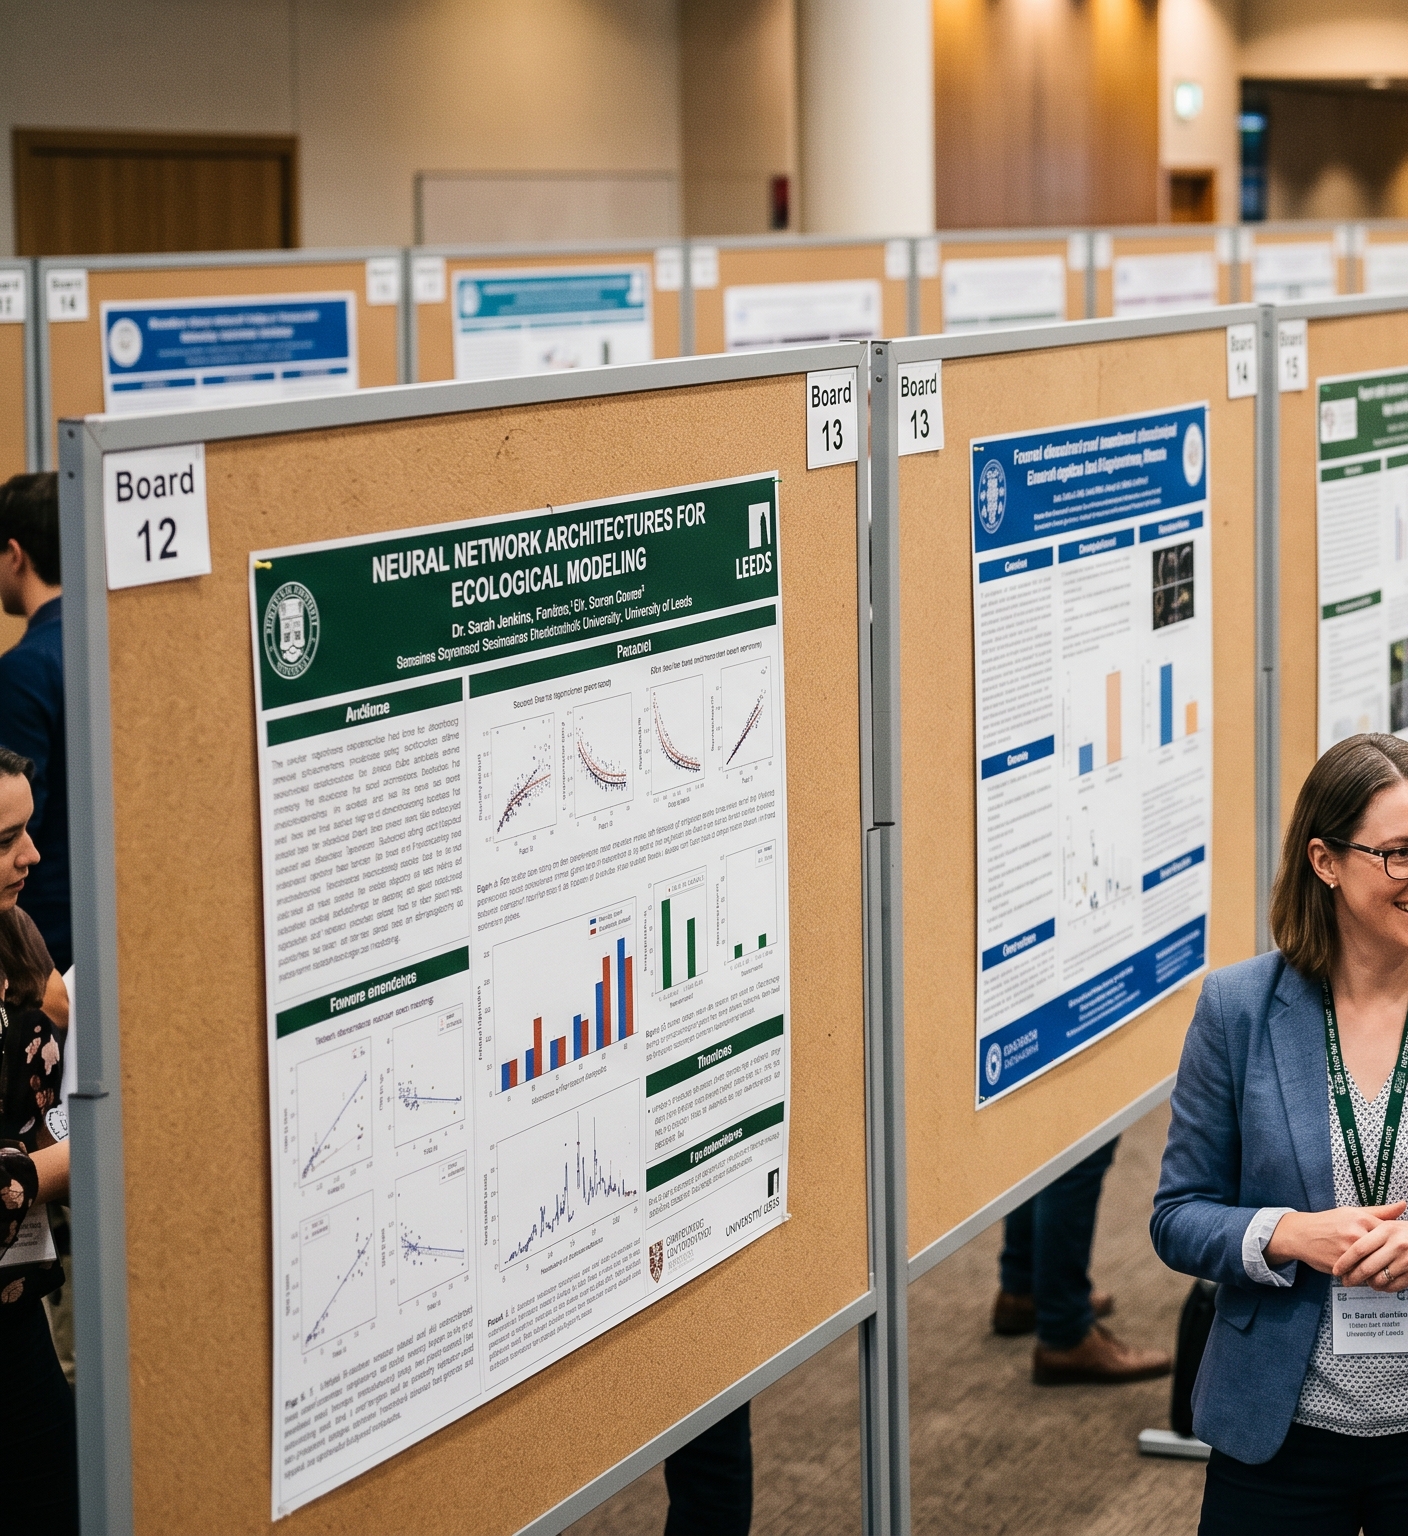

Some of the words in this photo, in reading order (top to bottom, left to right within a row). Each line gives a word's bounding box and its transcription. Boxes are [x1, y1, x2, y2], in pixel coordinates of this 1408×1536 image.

[811, 381, 852, 408] Board
[901, 373, 937, 398] Board
[822, 419, 843, 452] 13
[910, 409, 930, 440] 13
[116, 463, 194, 502] Board
[137, 517, 178, 562] 12
[372, 546, 450, 584] NEURAL
[454, 529, 542, 569] NETWORK
[545, 508, 673, 553] ARCHITECTURES
[677, 502, 706, 528] FOR
[452, 564, 563, 608] ECOLOGICAL
[567, 547, 647, 585] MODELING
[736, 551, 772, 580] LEEDS
[662, 599, 670, 612] of
[671, 595, 693, 611] Leeds
[452, 623, 466, 638] Dr.
[468, 617, 495, 635] Sarah
[497, 611, 534, 629] Jenkins,
